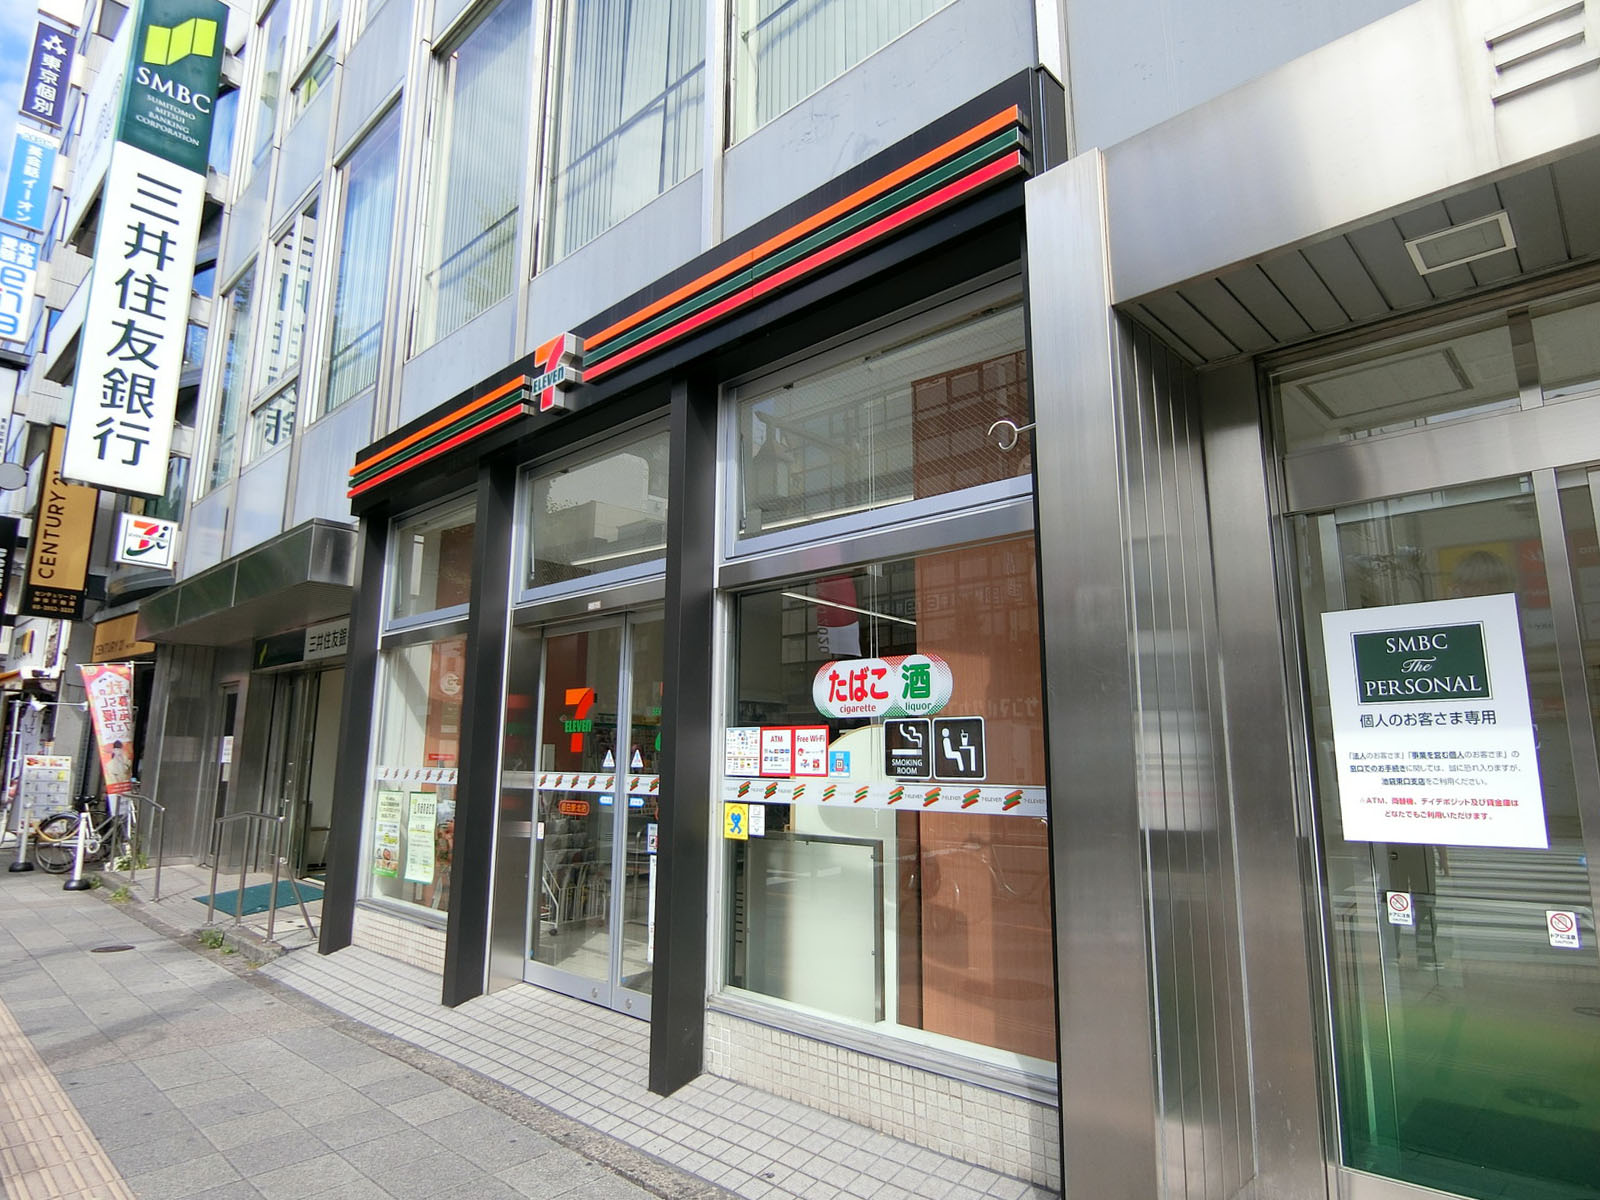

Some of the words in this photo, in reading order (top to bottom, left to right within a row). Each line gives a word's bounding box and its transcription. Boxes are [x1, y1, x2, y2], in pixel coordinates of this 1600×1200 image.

[32, 53, 63, 116] 東京個別
[136, 66, 211, 114] SMBC
[147, 94, 196, 120] SUMITOMO
[155, 106, 186, 124] MITSUI
[135, 114, 200, 146] CORPORATION
[148, 111, 190, 134] BANKING
[93, 173, 183, 467] 三井住友銀行
[38, 490, 67, 579] CENTURY
[1386, 633, 1448, 653] SMBC
[1401, 656, 1437, 673] The
[828, 666, 889, 703] たばこ
[902, 663, 931, 699] 酒
[1365, 675, 1482, 697] PERSONAL
[839, 703, 877, 715] cigarette
[905, 702, 933, 713] liquor
[1360, 710, 1497, 728] 個人のお客さま専用
[770, 735, 784, 743] ATM
[796, 735, 809, 743] Free
[810, 734, 826, 743] Wi-Fi
[891, 758, 923, 767] SMOKING
[896, 766, 918, 775] ROOM
